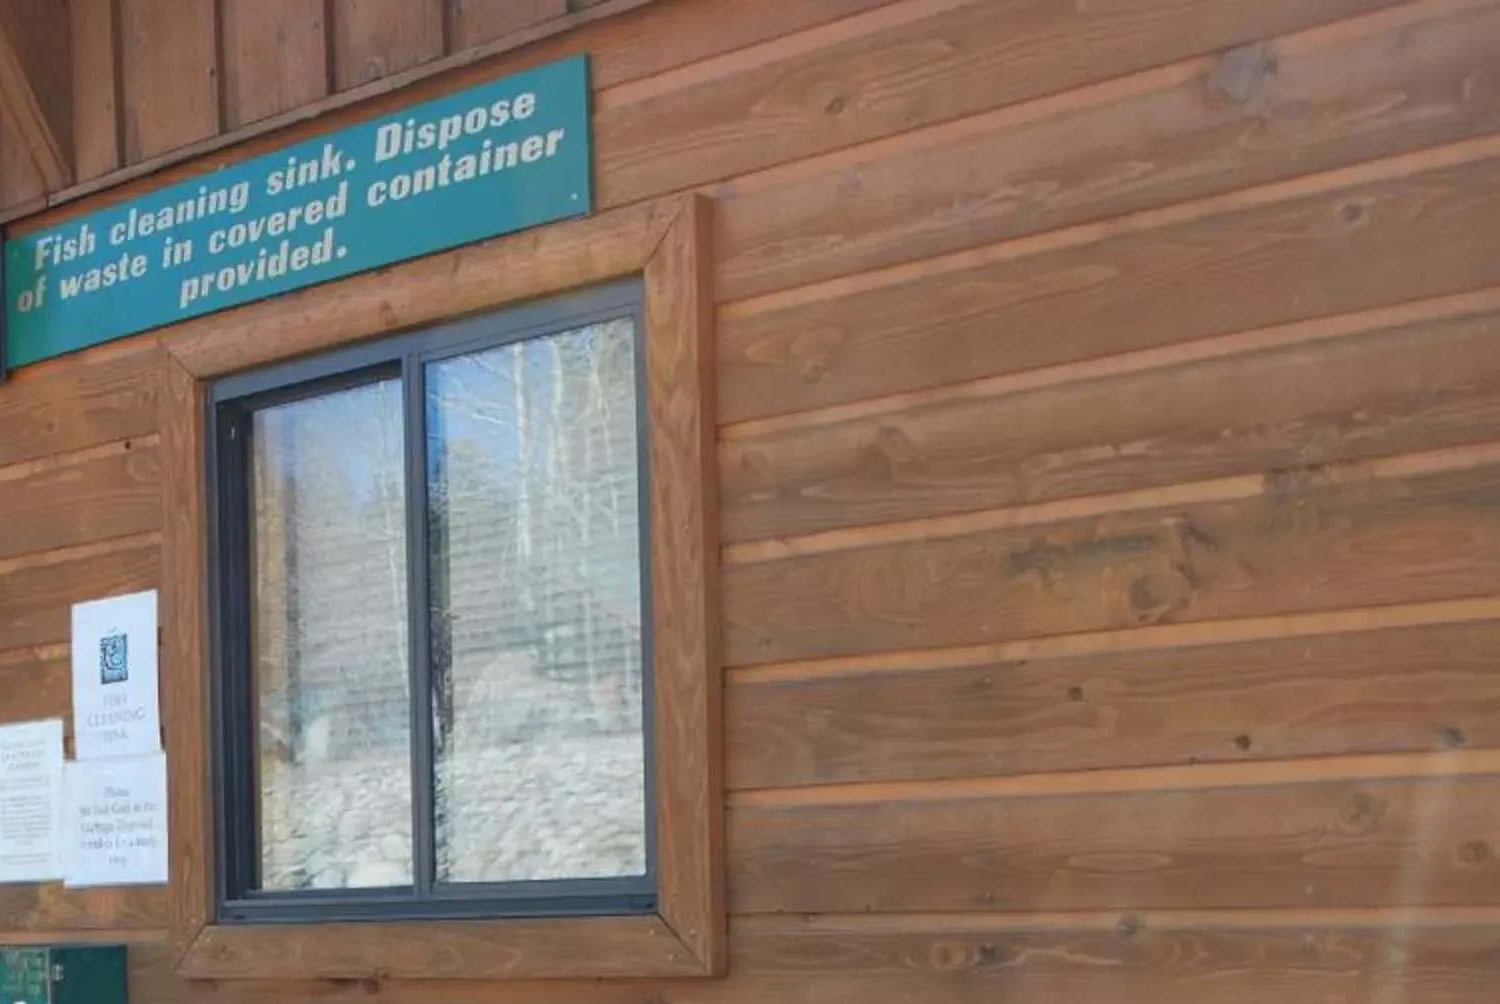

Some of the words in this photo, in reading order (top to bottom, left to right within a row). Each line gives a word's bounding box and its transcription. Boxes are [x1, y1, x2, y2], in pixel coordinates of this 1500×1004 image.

[17, 277, 47, 314] of
[59, 254, 148, 301] waste
[162, 236, 193, 269] in
[208, 183, 349, 254] covered
[367, 126, 565, 207] container
[34, 224, 96, 271] Fish
[109, 183, 250, 246] cleaning
[266, 146, 356, 195] sink.
[374, 92, 536, 164] Dispose
[179, 227, 349, 309] provided.
